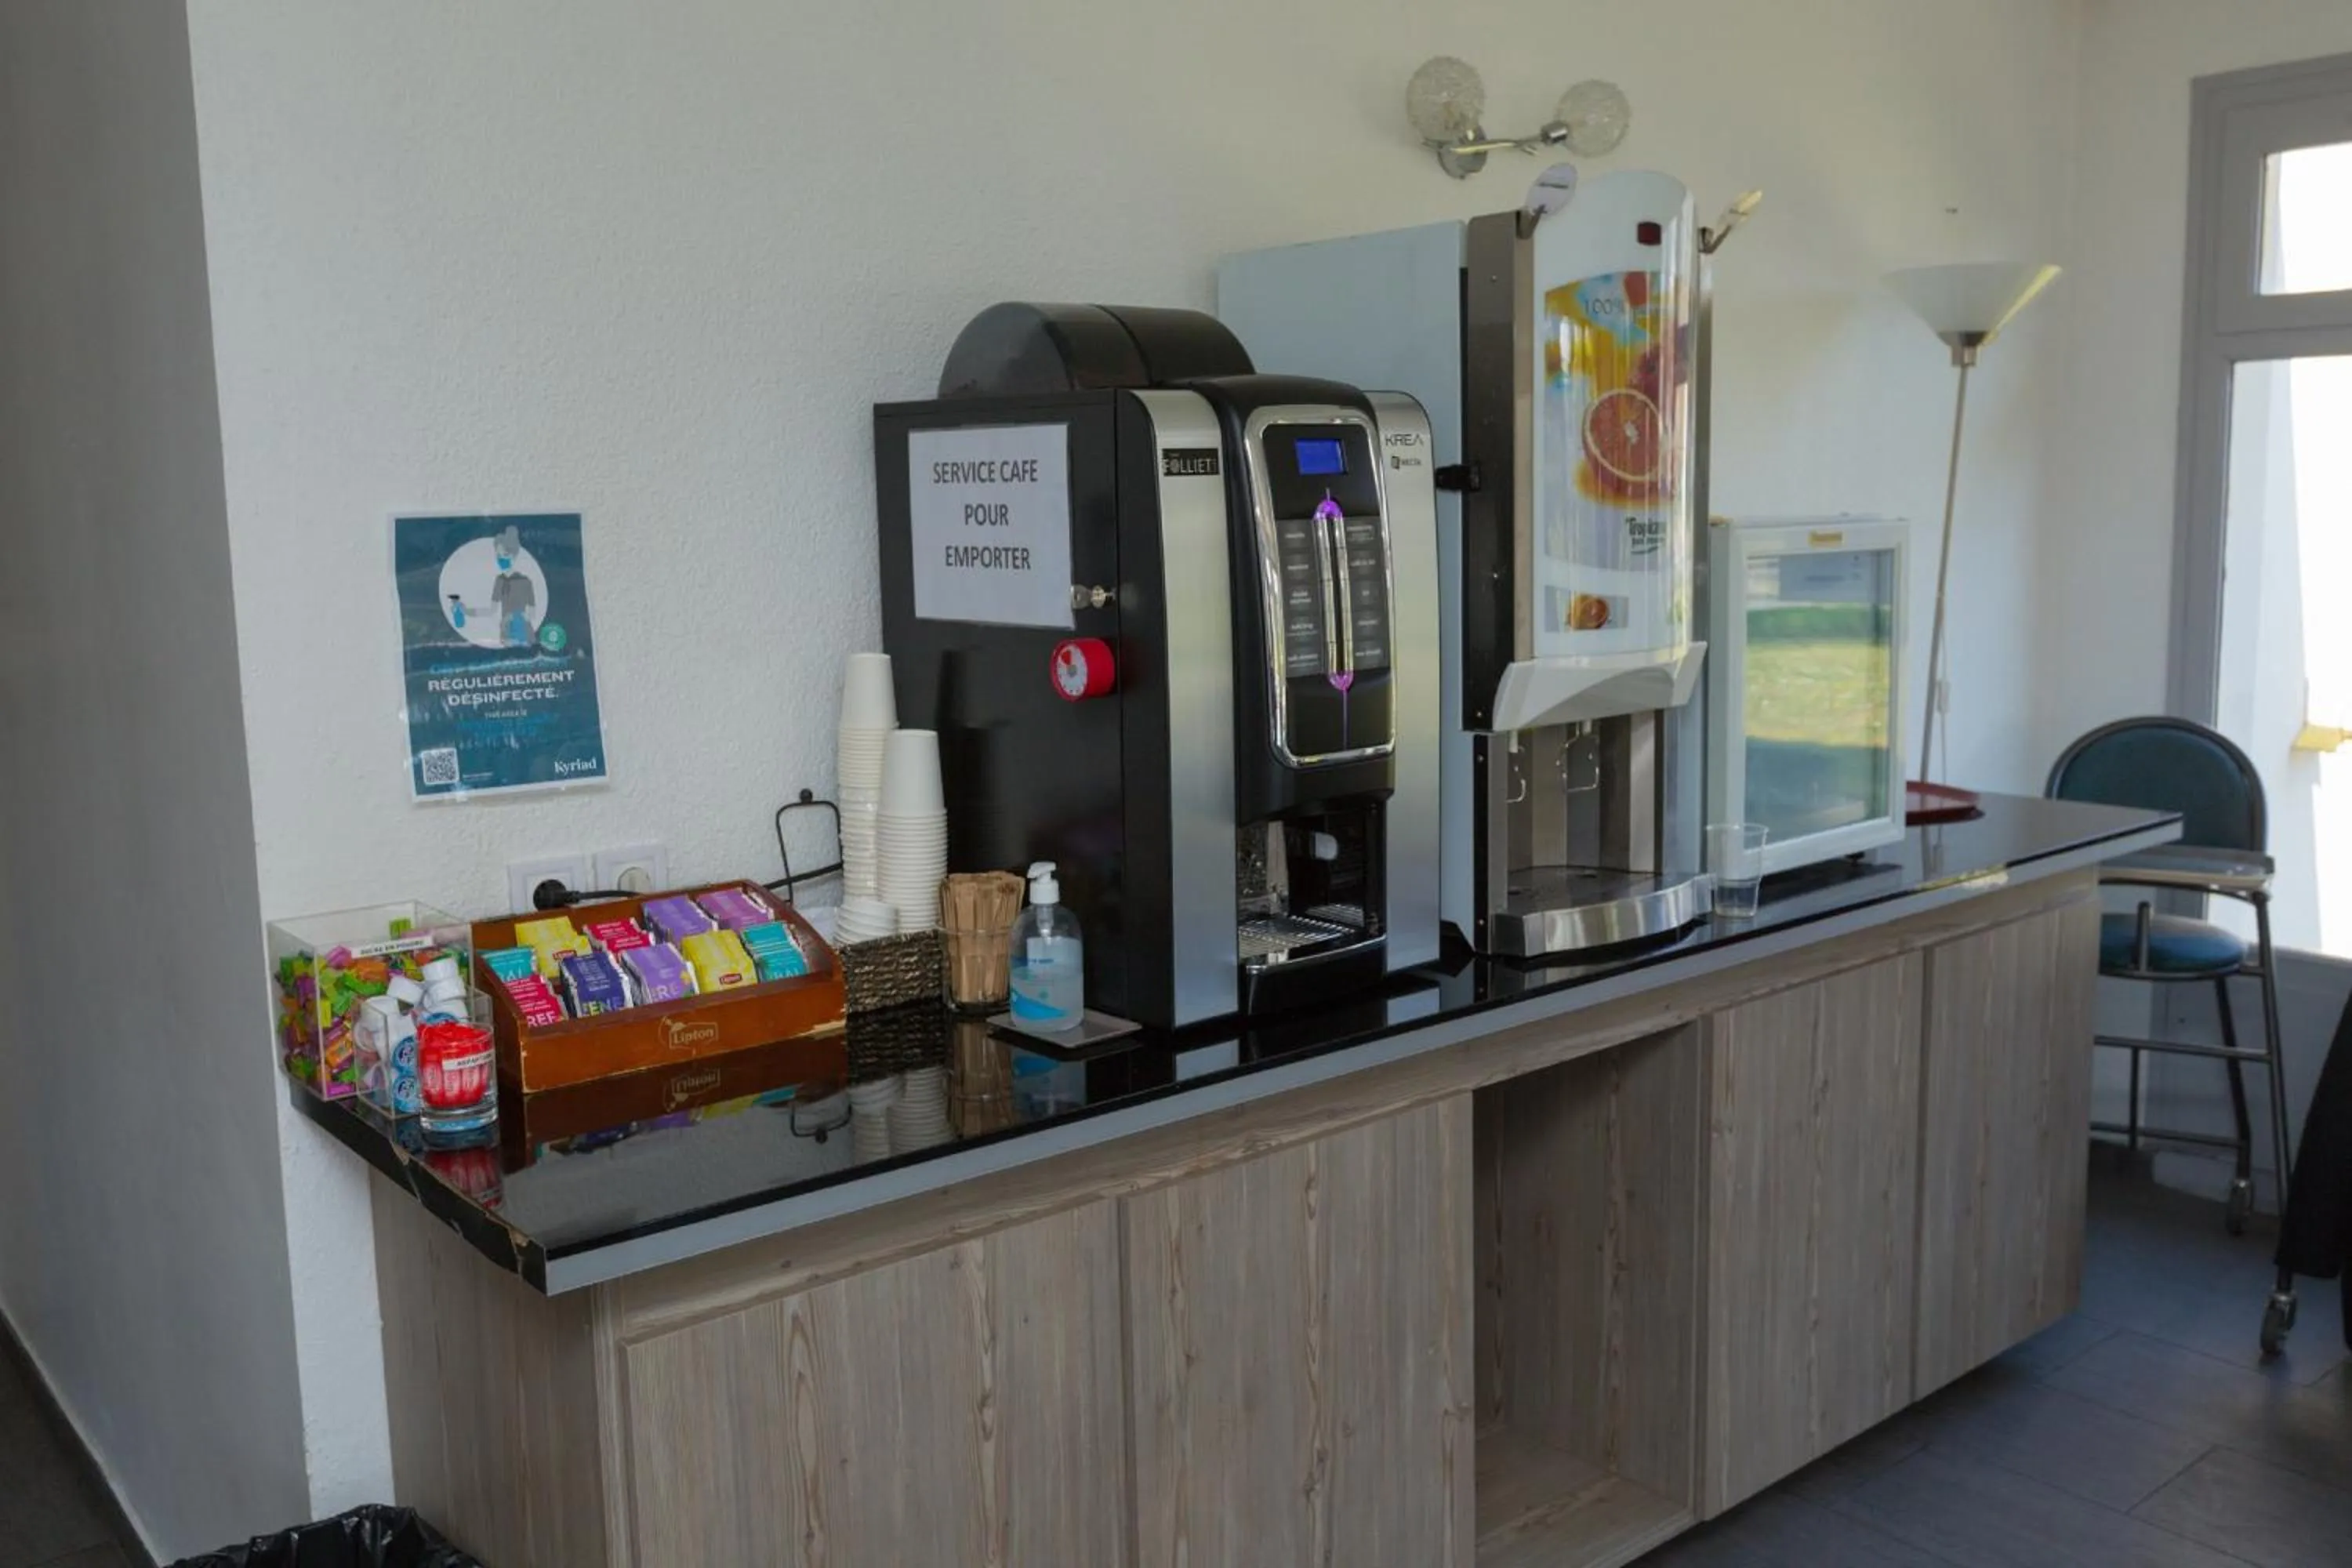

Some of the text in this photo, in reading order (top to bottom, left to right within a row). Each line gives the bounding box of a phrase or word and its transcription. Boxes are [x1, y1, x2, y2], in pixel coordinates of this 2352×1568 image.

[933, 459, 1038, 484] SERVICE CAFE
[964, 503, 1009, 526] POUR
[946, 546, 1031, 570] EMPORTER
[554, 757, 597, 776] Kyriad
[674, 1028, 714, 1045] Lipton
